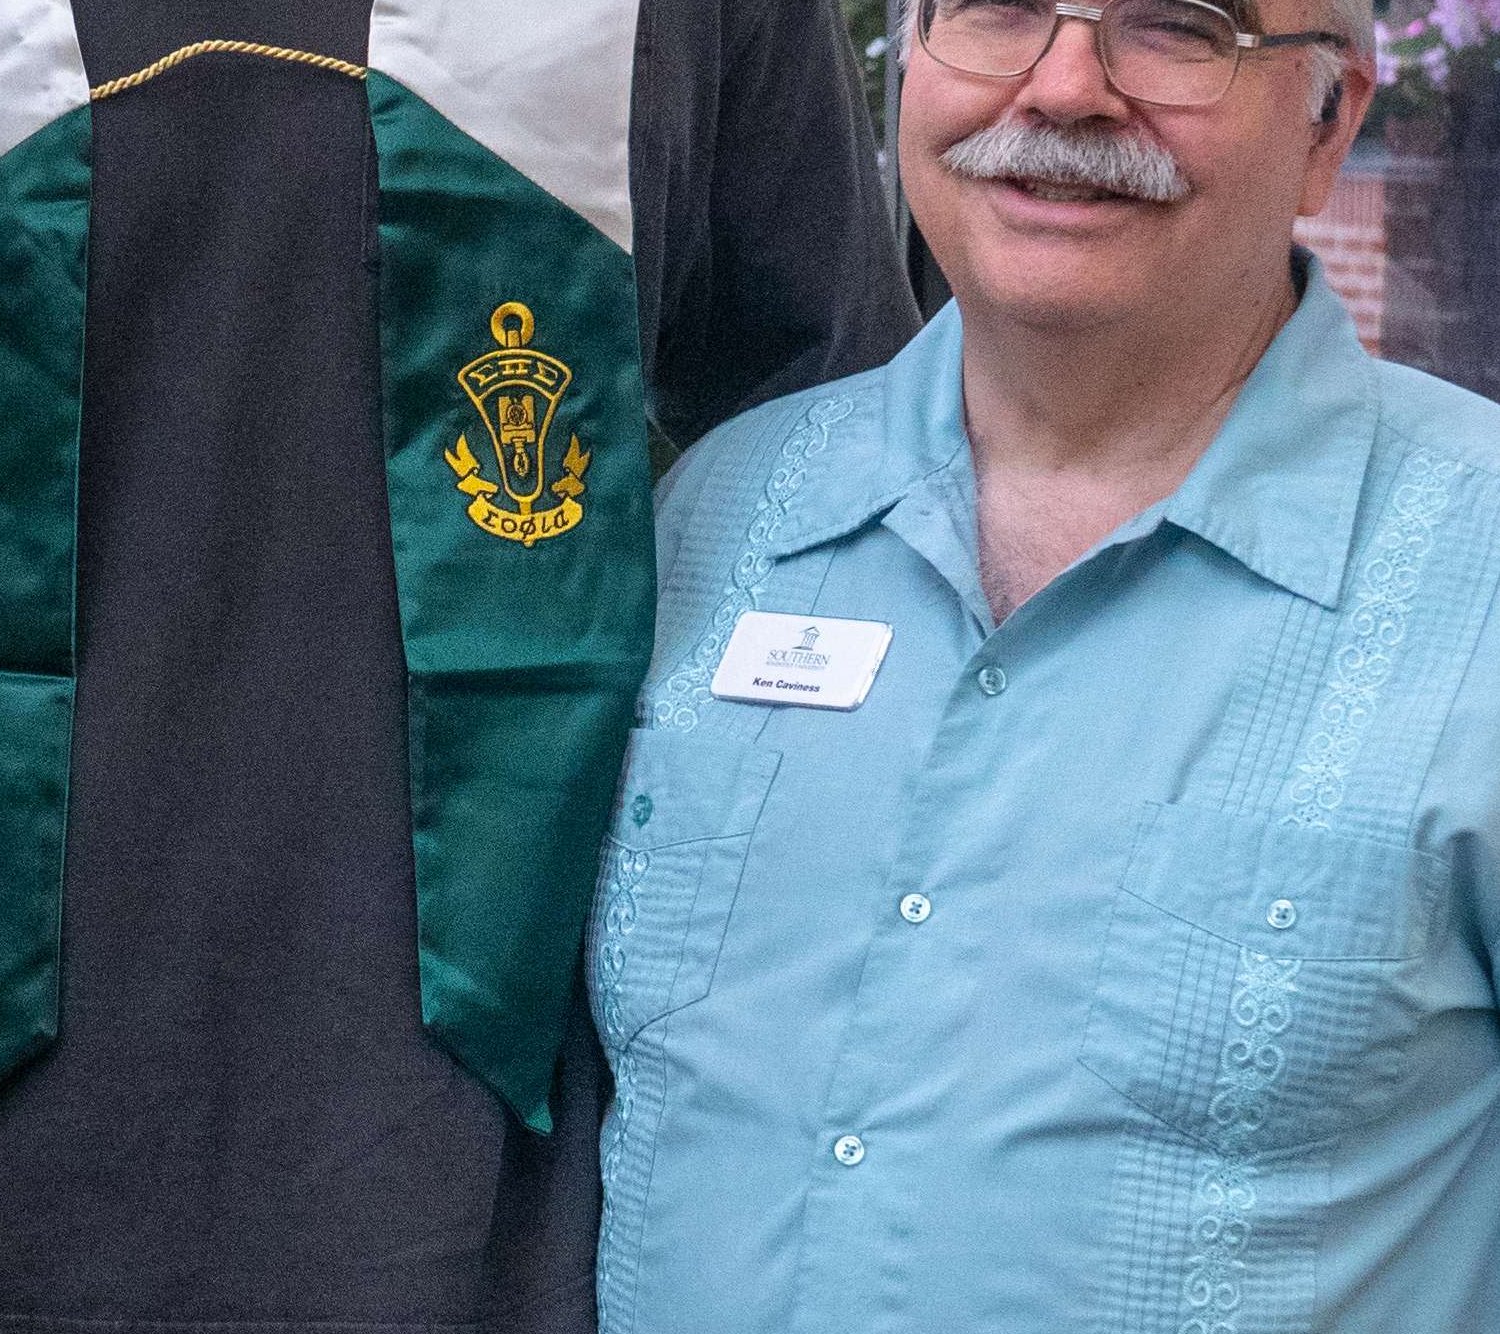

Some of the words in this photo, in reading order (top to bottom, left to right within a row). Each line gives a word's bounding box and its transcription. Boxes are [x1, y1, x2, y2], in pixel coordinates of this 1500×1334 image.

[767, 649, 832, 666] SOUTHERN
[752, 676, 774, 688] Ken
[775, 679, 821, 693] Caviness
